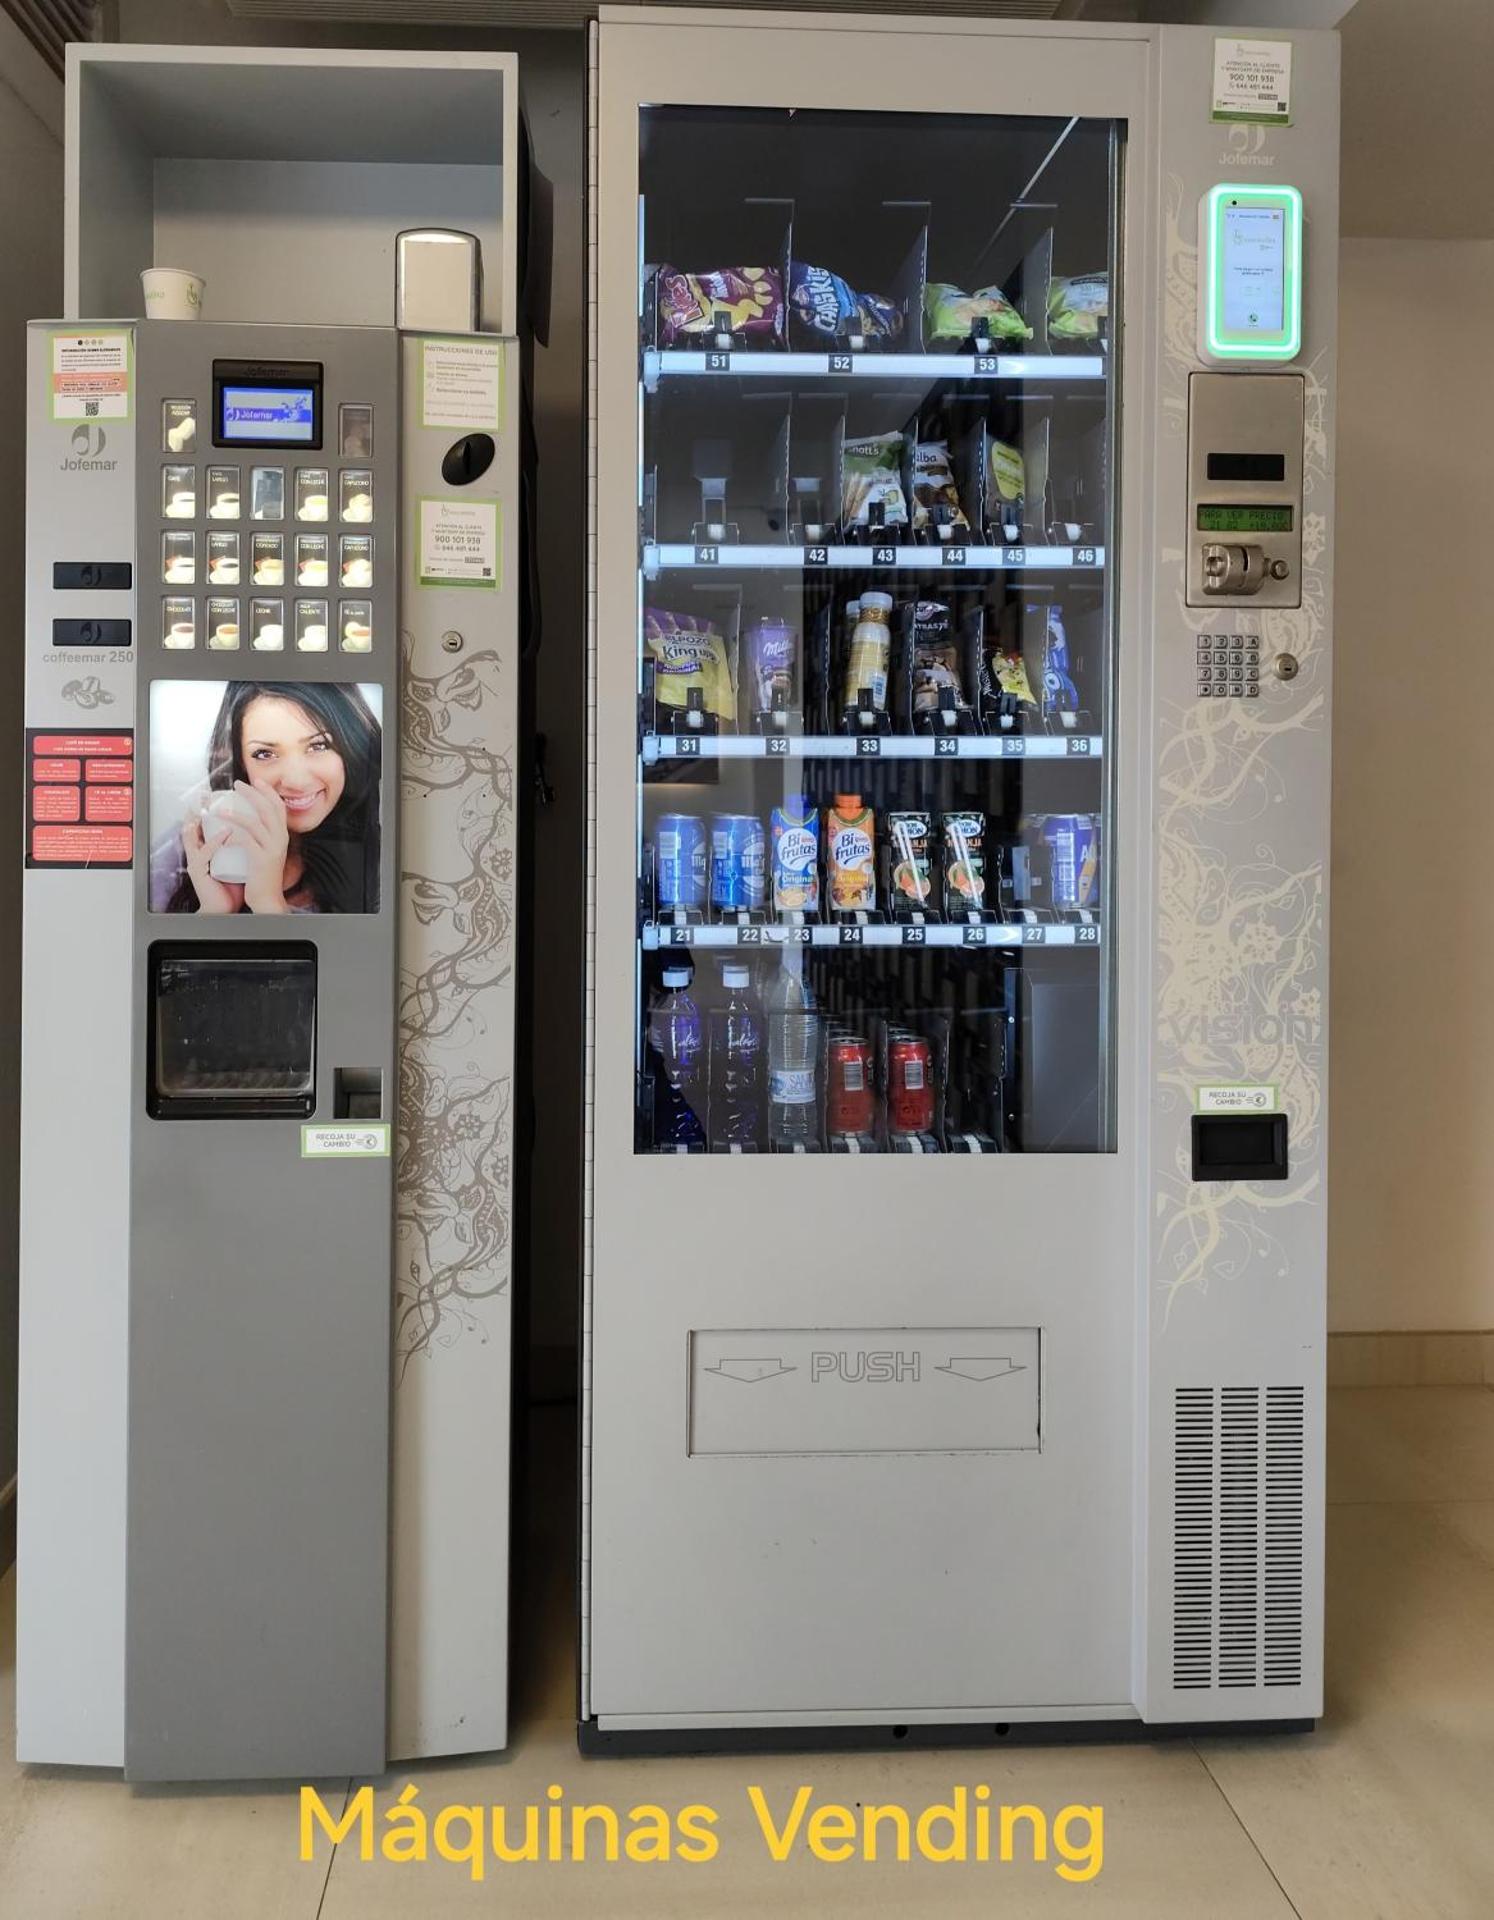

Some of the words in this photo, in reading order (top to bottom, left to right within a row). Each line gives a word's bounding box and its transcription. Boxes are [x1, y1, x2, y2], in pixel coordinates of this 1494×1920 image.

[1229, 73, 1244, 81] 900
[1246, 74, 1258, 82] 101
[1218, 152, 1275, 166] Jofemar
[711, 354, 727, 367] 51
[833, 356, 850, 370] 52
[979, 358, 996, 371] 53
[60, 457, 118, 472] Jofemar
[435, 535, 450, 544] 900
[452, 536, 464, 544] 101
[700, 549, 716, 561] 41
[809, 549, 825, 562] 42
[877, 549, 893, 562] 43
[947, 549, 963, 562] 44
[1007, 549, 1023, 562] 45
[1077, 549, 1093, 562] 46
[42, 651, 106, 664] coffeemar
[109, 650, 134, 664] 250
[662, 644, 697, 660] King
[681, 738, 696, 752] 31
[771, 738, 787, 752] 32
[862, 739, 878, 752] 33
[940, 739, 956, 752] 34
[1007, 739, 1023, 752] 35
[1072, 739, 1088, 752] 36
[788, 833, 800, 846] Bi
[841, 833, 854, 846] Bi
[780, 843, 817, 860] frutas
[835, 843, 870, 860] frutas
[675, 929, 691, 942] 21
[742, 929, 758, 942] 22
[794, 929, 810, 942] 23
[844, 929, 861, 941] 24
[907, 928, 923, 941] 25
[968, 928, 984, 941] 26
[1027, 928, 1043, 940] 27
[1079, 927, 1095, 940] 28
[1209, 1091, 1235, 1099] RECOJA
[1237, 1091, 1247, 1099] SU
[811, 1351, 921, 1383] PUSH
